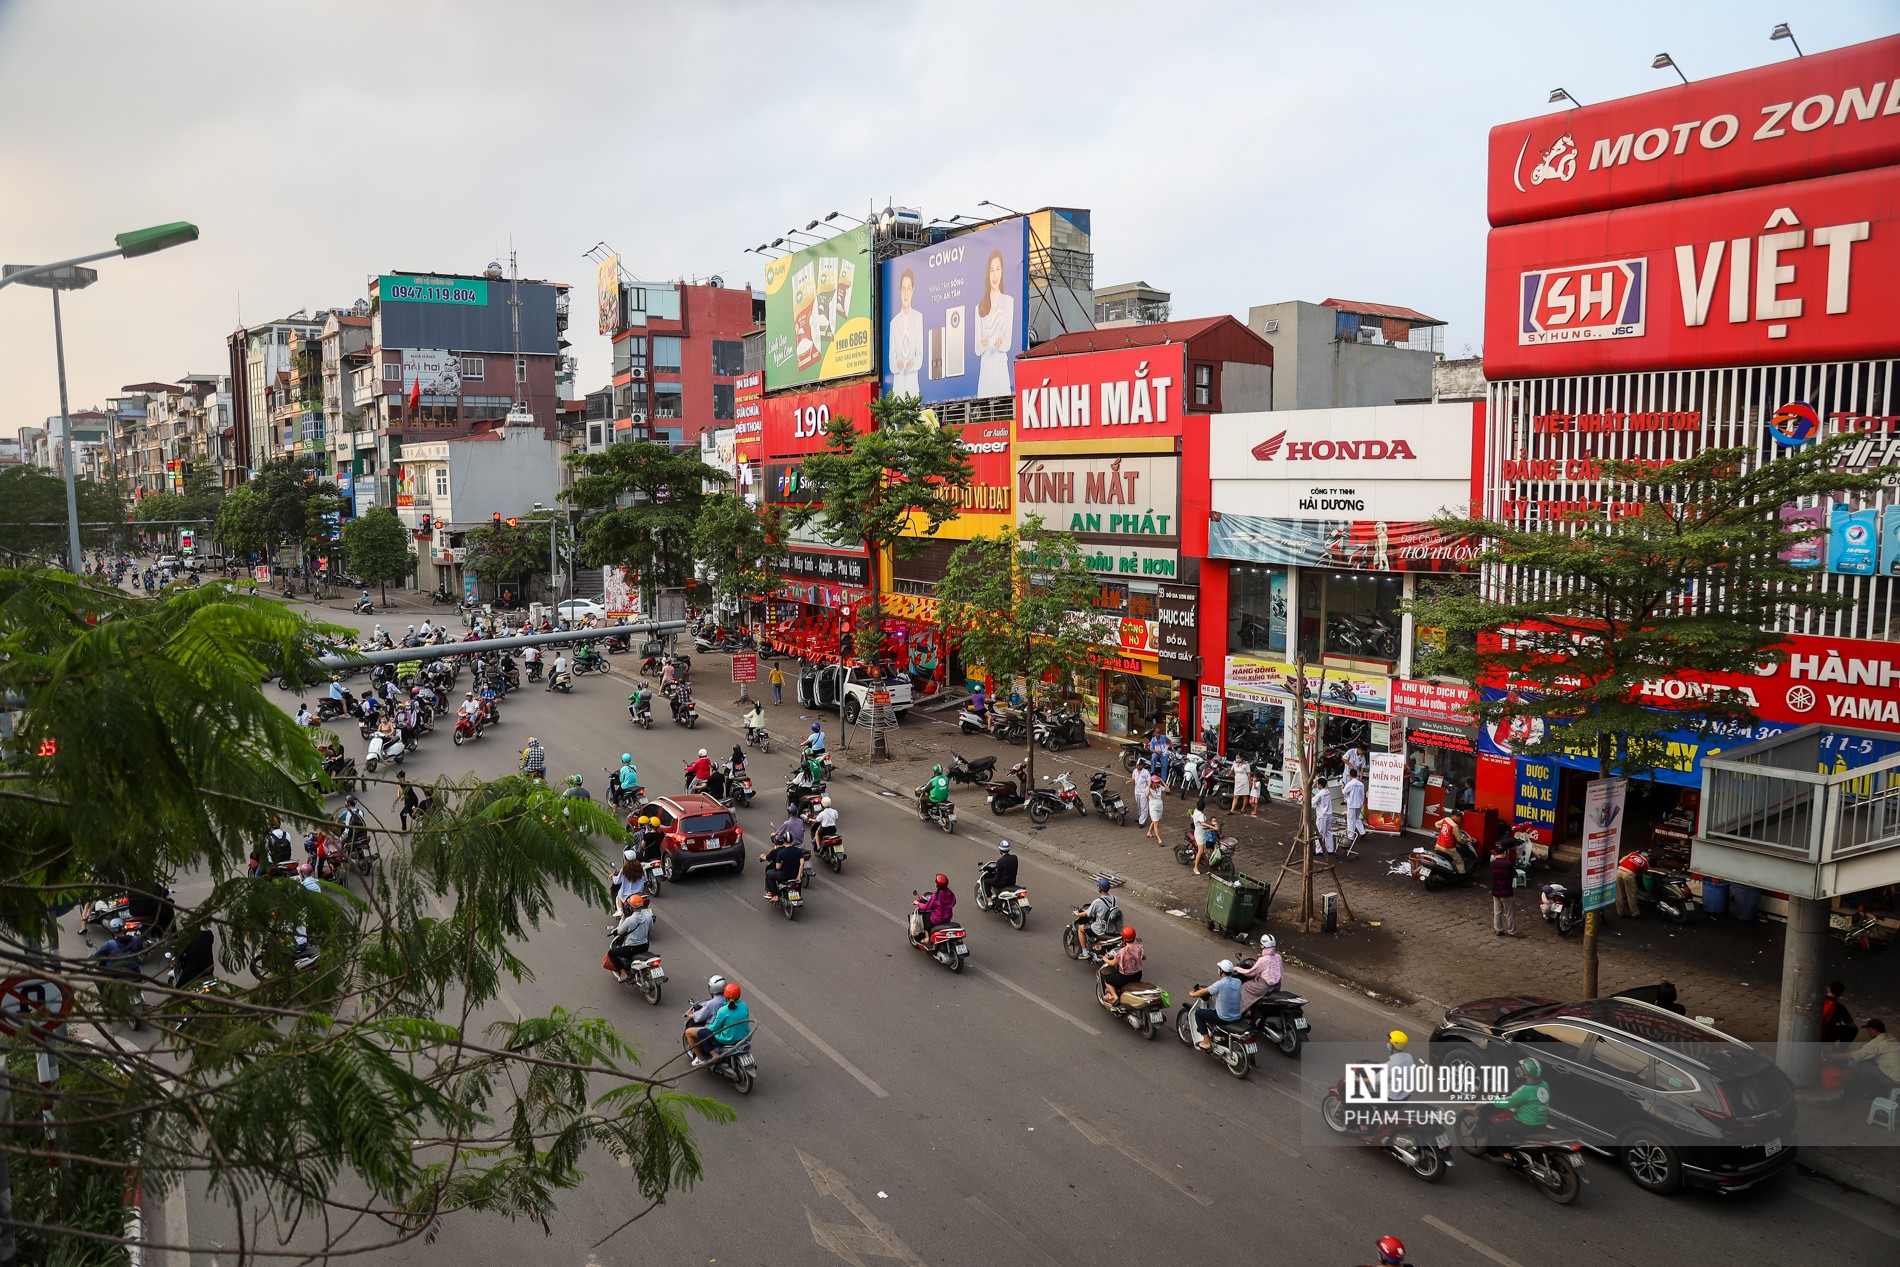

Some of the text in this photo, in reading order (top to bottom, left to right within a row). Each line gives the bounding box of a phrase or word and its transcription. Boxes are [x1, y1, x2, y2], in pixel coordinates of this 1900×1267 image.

[1588, 114, 1740, 171] MOTO
[1675, 207, 1870, 339] VIỆT
[391, 285, 477, 302] 0947.119.804
[1546, 271, 1614, 326] SH
[849, 329, 868, 348] 6869
[1611, 325, 1634, 336] JSC
[1021, 360, 1173, 430] KÍNH MẮT
[793, 404, 830, 438] 190
[1533, 407, 1700, 438] VIỆT NHẬT MOTOR
[992, 427, 1009, 437] Audio
[1286, 439, 1417, 461] HONDA
[778, 475, 798, 488] FPT
[1019, 456, 1140, 505] KÍNH MẮT
[988, 486, 1011, 512] ĐẠT
[1310, 487, 1328, 495] CÔNG
[1299, 495, 1365, 511] HẢI DƯƠNG
[1069, 508, 1171, 535] AN PHÁT
[819, 558, 833, 577] Apple
[838, 560, 848, 580] Phụ
[848, 560, 861, 581] kiện
[1119, 551, 1138, 573] RẺ
[1142, 558, 1175, 576] HƠN
[1158, 604, 1195, 628] PHỤC CHẾ
[1177, 636, 1187, 646] DA
[1790, 649, 1900, 688] HÀNH
[1202, 686, 1220, 694] HEAD
[1248, 694, 1259, 702] 182
[1401, 682, 1469, 702] KHU VỰC DỊCH VỤ
[1363, 712, 1385, 721] HEAD
[1443, 724, 1455, 732] Dịch
[1371, 759, 1403, 769] THAY DẦU
[1526, 764, 1550, 781] ĐƯỢC
[1372, 771, 1401, 782] MIỄN PHÍ
[1521, 782, 1553, 802] RỬA XE
[1515, 802, 1556, 824] MIỄN PHÍ
